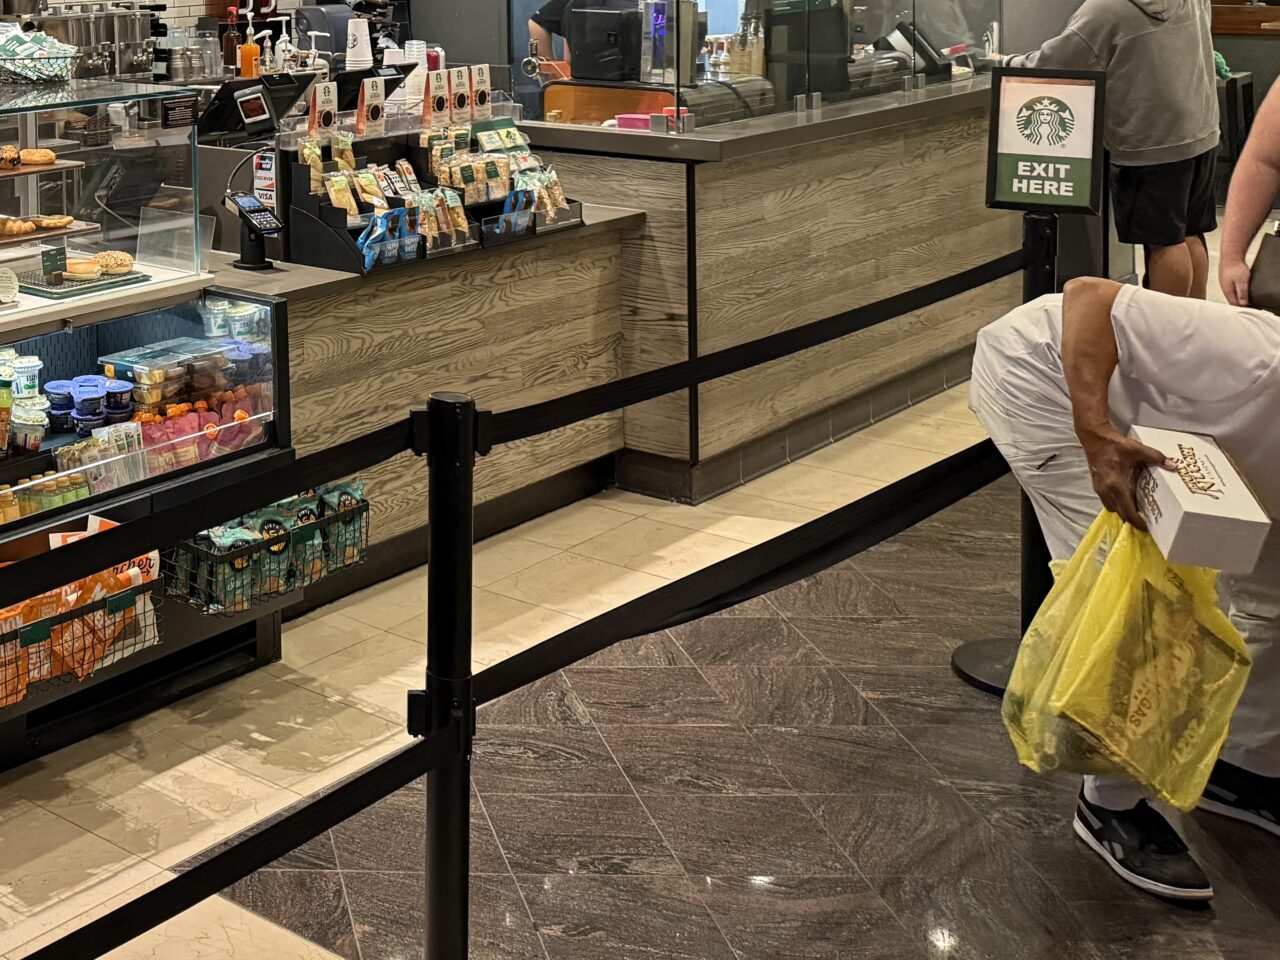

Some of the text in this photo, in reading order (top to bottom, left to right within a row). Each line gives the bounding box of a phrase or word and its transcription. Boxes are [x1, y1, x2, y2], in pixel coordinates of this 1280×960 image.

[1017, 161, 1071, 179] EXIT
[1012, 178, 1074, 196] HERE
[258, 192, 273, 201] VISA
